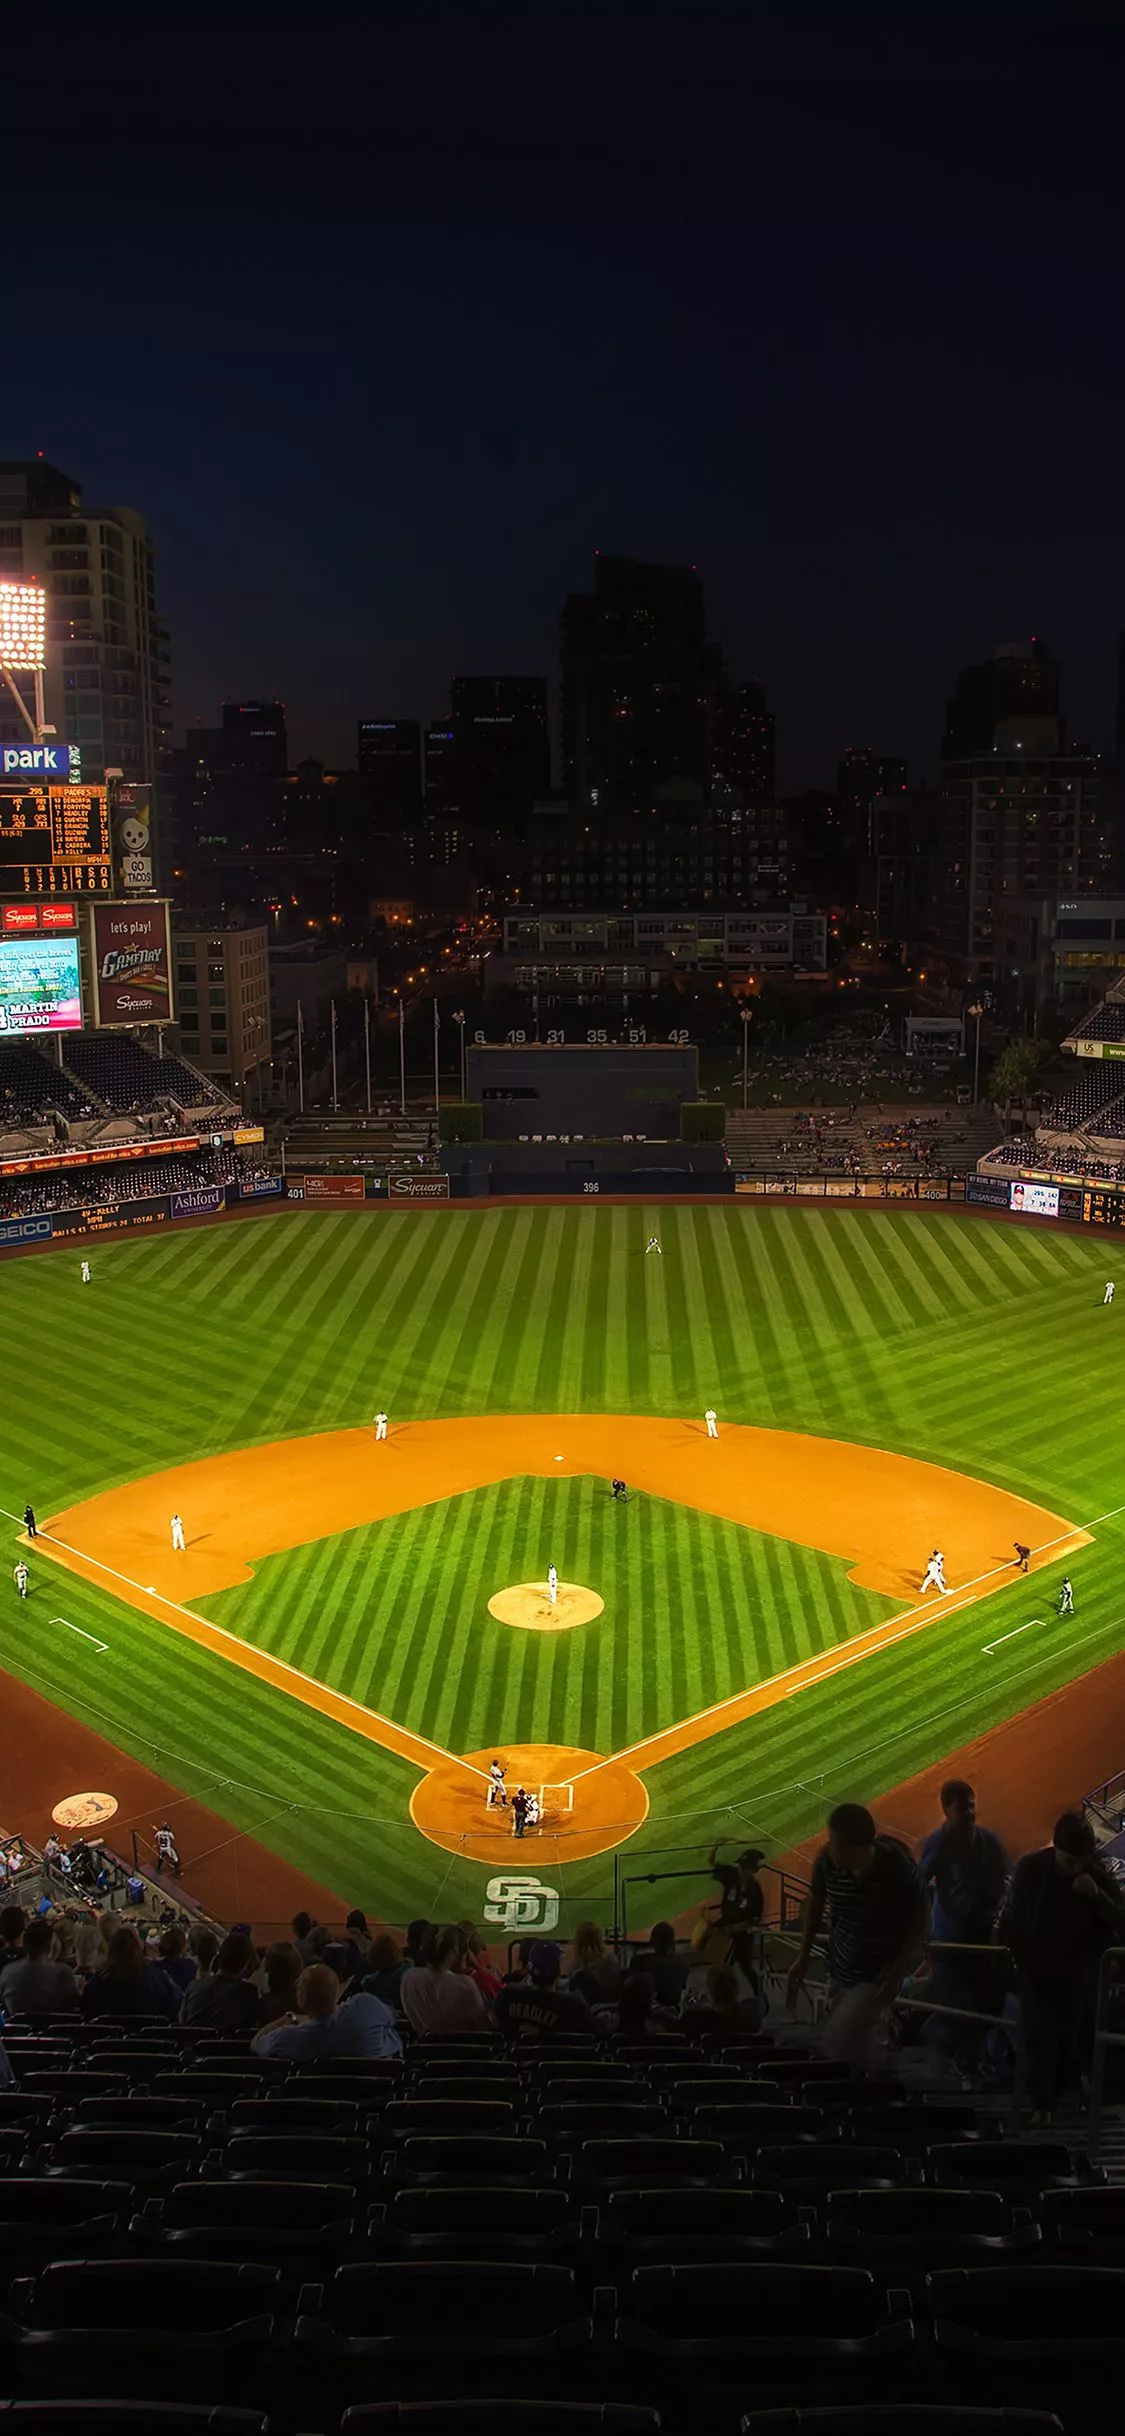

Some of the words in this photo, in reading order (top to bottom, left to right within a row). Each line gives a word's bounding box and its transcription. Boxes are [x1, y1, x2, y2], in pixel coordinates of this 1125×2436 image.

[4, 747, 58, 773] park
[63, 788, 92, 796] PADRES
[75, 867, 83, 877] B
[88, 866, 96, 877] S
[131, 861, 144, 871] GO
[128, 872, 152, 882] TACOS
[5, 910, 38, 924] Sycuan
[42, 909, 74, 922] Sycuan
[110, 922, 129, 933] let's
[130, 920, 152, 935] play!
[10, 1002, 58, 1014] MARTIN
[117, 995, 152, 1011] Sycuan
[11, 1015, 50, 1027] PRADO
[474, 1031, 485, 1042] 6
[508, 1031, 526, 1042] 19
[548, 1030, 565, 1041] 31
[587, 1030, 607, 1042] 35
[629, 1030, 646, 1042] 51
[668, 1030, 689, 1042] 42
[242, 1184, 254, 1193] us
[254, 1180, 278, 1192] bank
[391, 1178, 448, 1196] Sycuan
[583, 1182, 600, 1193] 396
[175, 1190, 220, 1209] Ashford
[287, 1189, 304, 1199] 401
[925, 1190, 941, 1200] 400
[990, 1195, 1008, 1205] DIEGO
[97, 1205, 120, 1216] KELLY
[132, 1215, 154, 1224] TOTAL
[0, 1221, 50, 1239] GEICO
[484, 1876, 559, 1932] SD
[508, 2002, 559, 2027] HEADLEY
